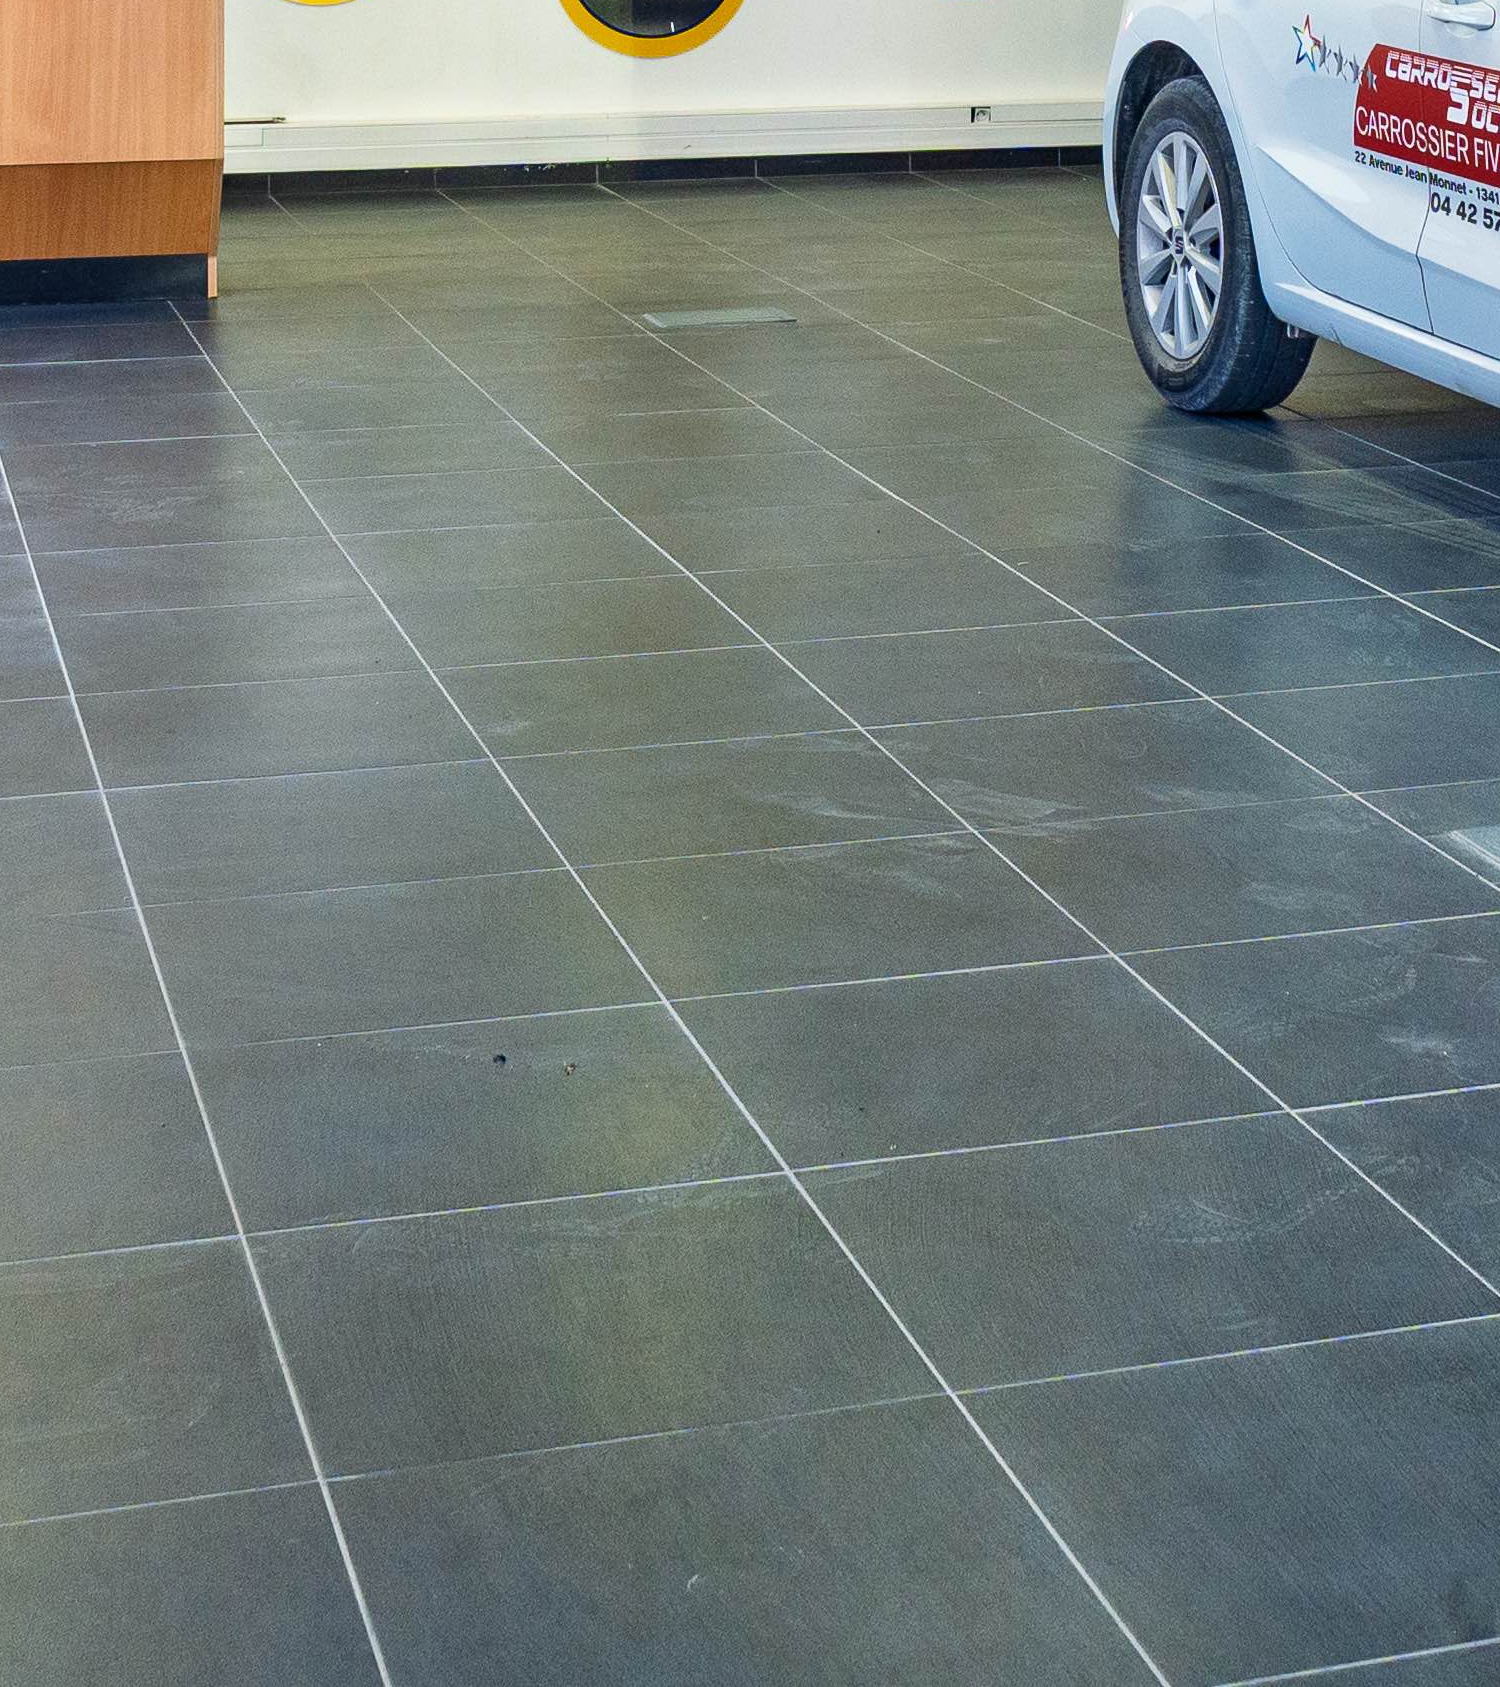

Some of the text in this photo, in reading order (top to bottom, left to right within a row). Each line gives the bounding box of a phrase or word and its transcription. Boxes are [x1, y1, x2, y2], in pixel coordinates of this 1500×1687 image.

[1355, 106, 1470, 166] CARROSSIER
[1355, 150, 1367, 165] 22
[1369, 154, 1404, 176] Avenue
[1404, 164, 1428, 184] Jean
[1429, 171, 1467, 195] Monnet
[1430, 192, 1452, 216] 04
[1456, 200, 1478, 224] 42
